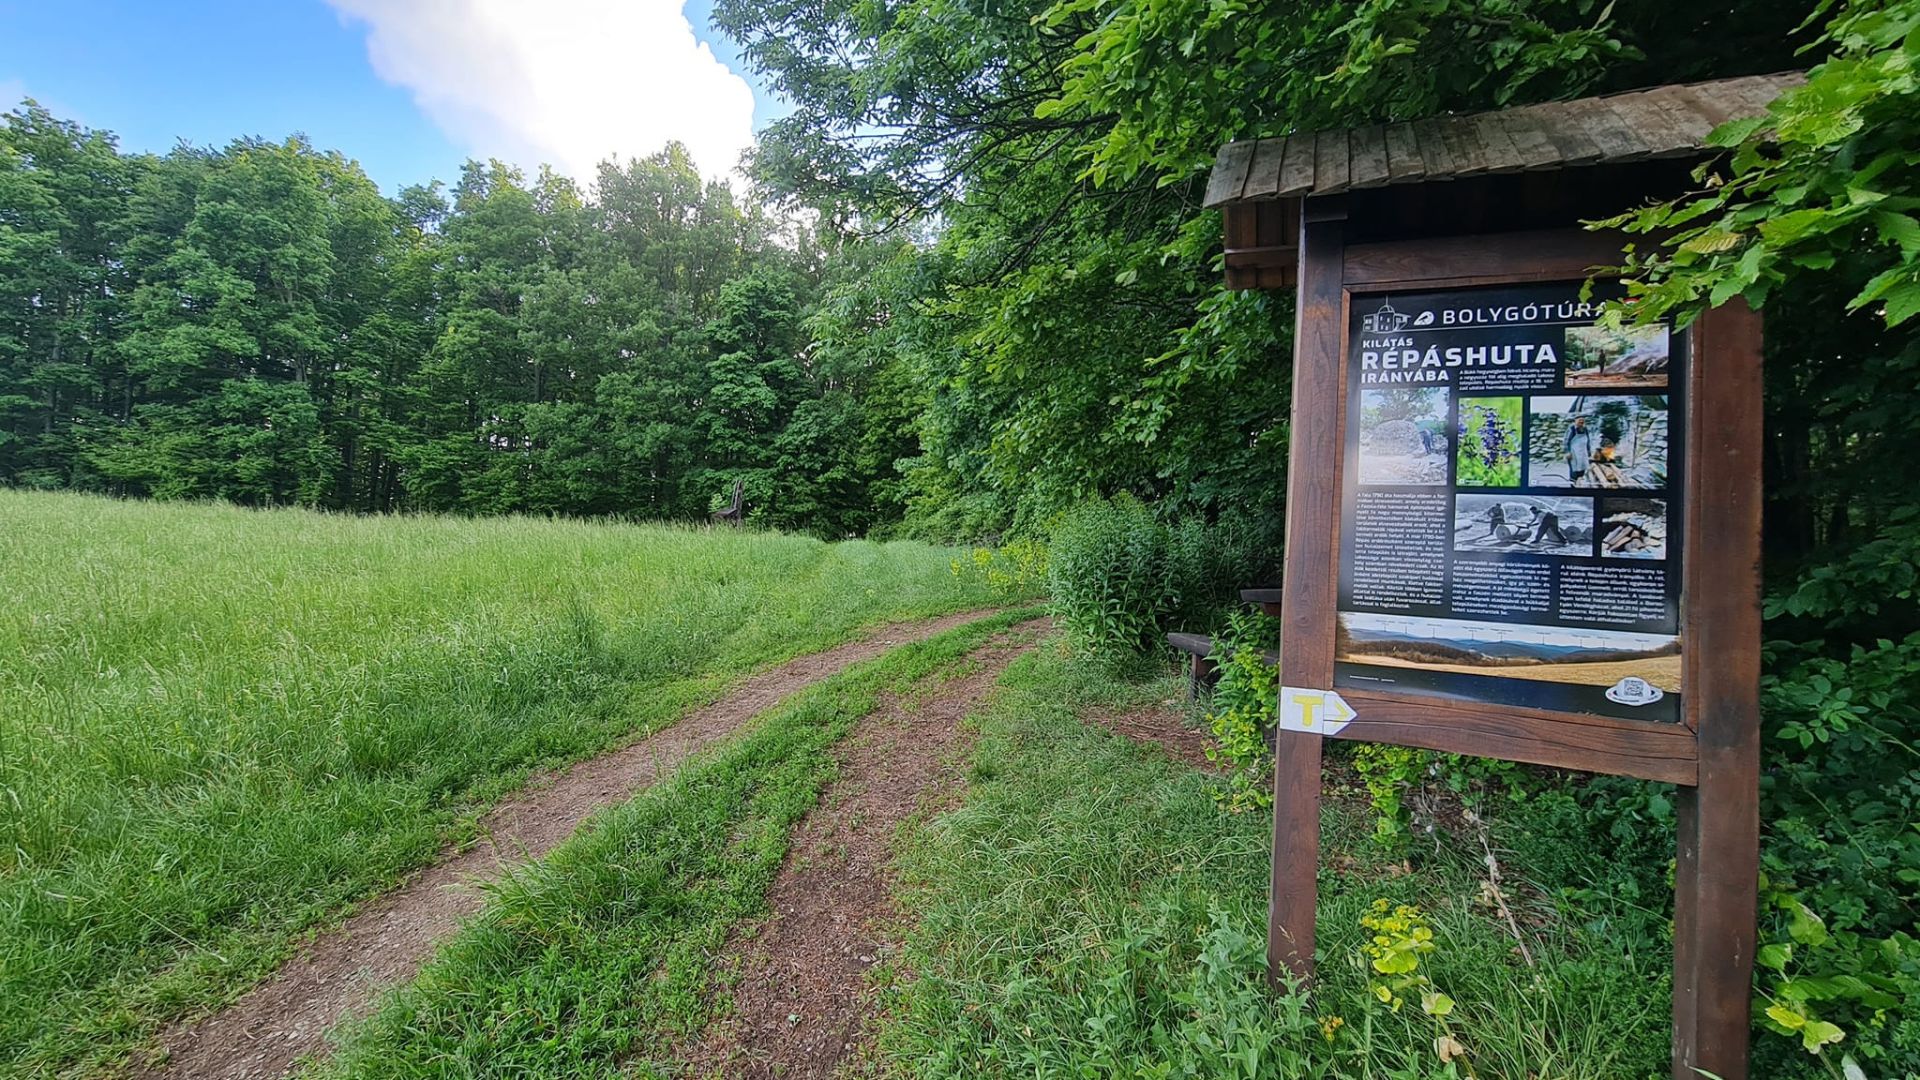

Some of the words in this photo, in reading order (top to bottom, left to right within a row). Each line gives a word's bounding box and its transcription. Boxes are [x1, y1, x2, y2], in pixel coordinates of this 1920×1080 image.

[1362, 337, 1413, 348] KILÁTÁS
[1361, 344, 1557, 370] RÉPÁSHUTA
[1361, 368, 1449, 384] IRÁNYÁBA
[1292, 695, 1324, 728] T
